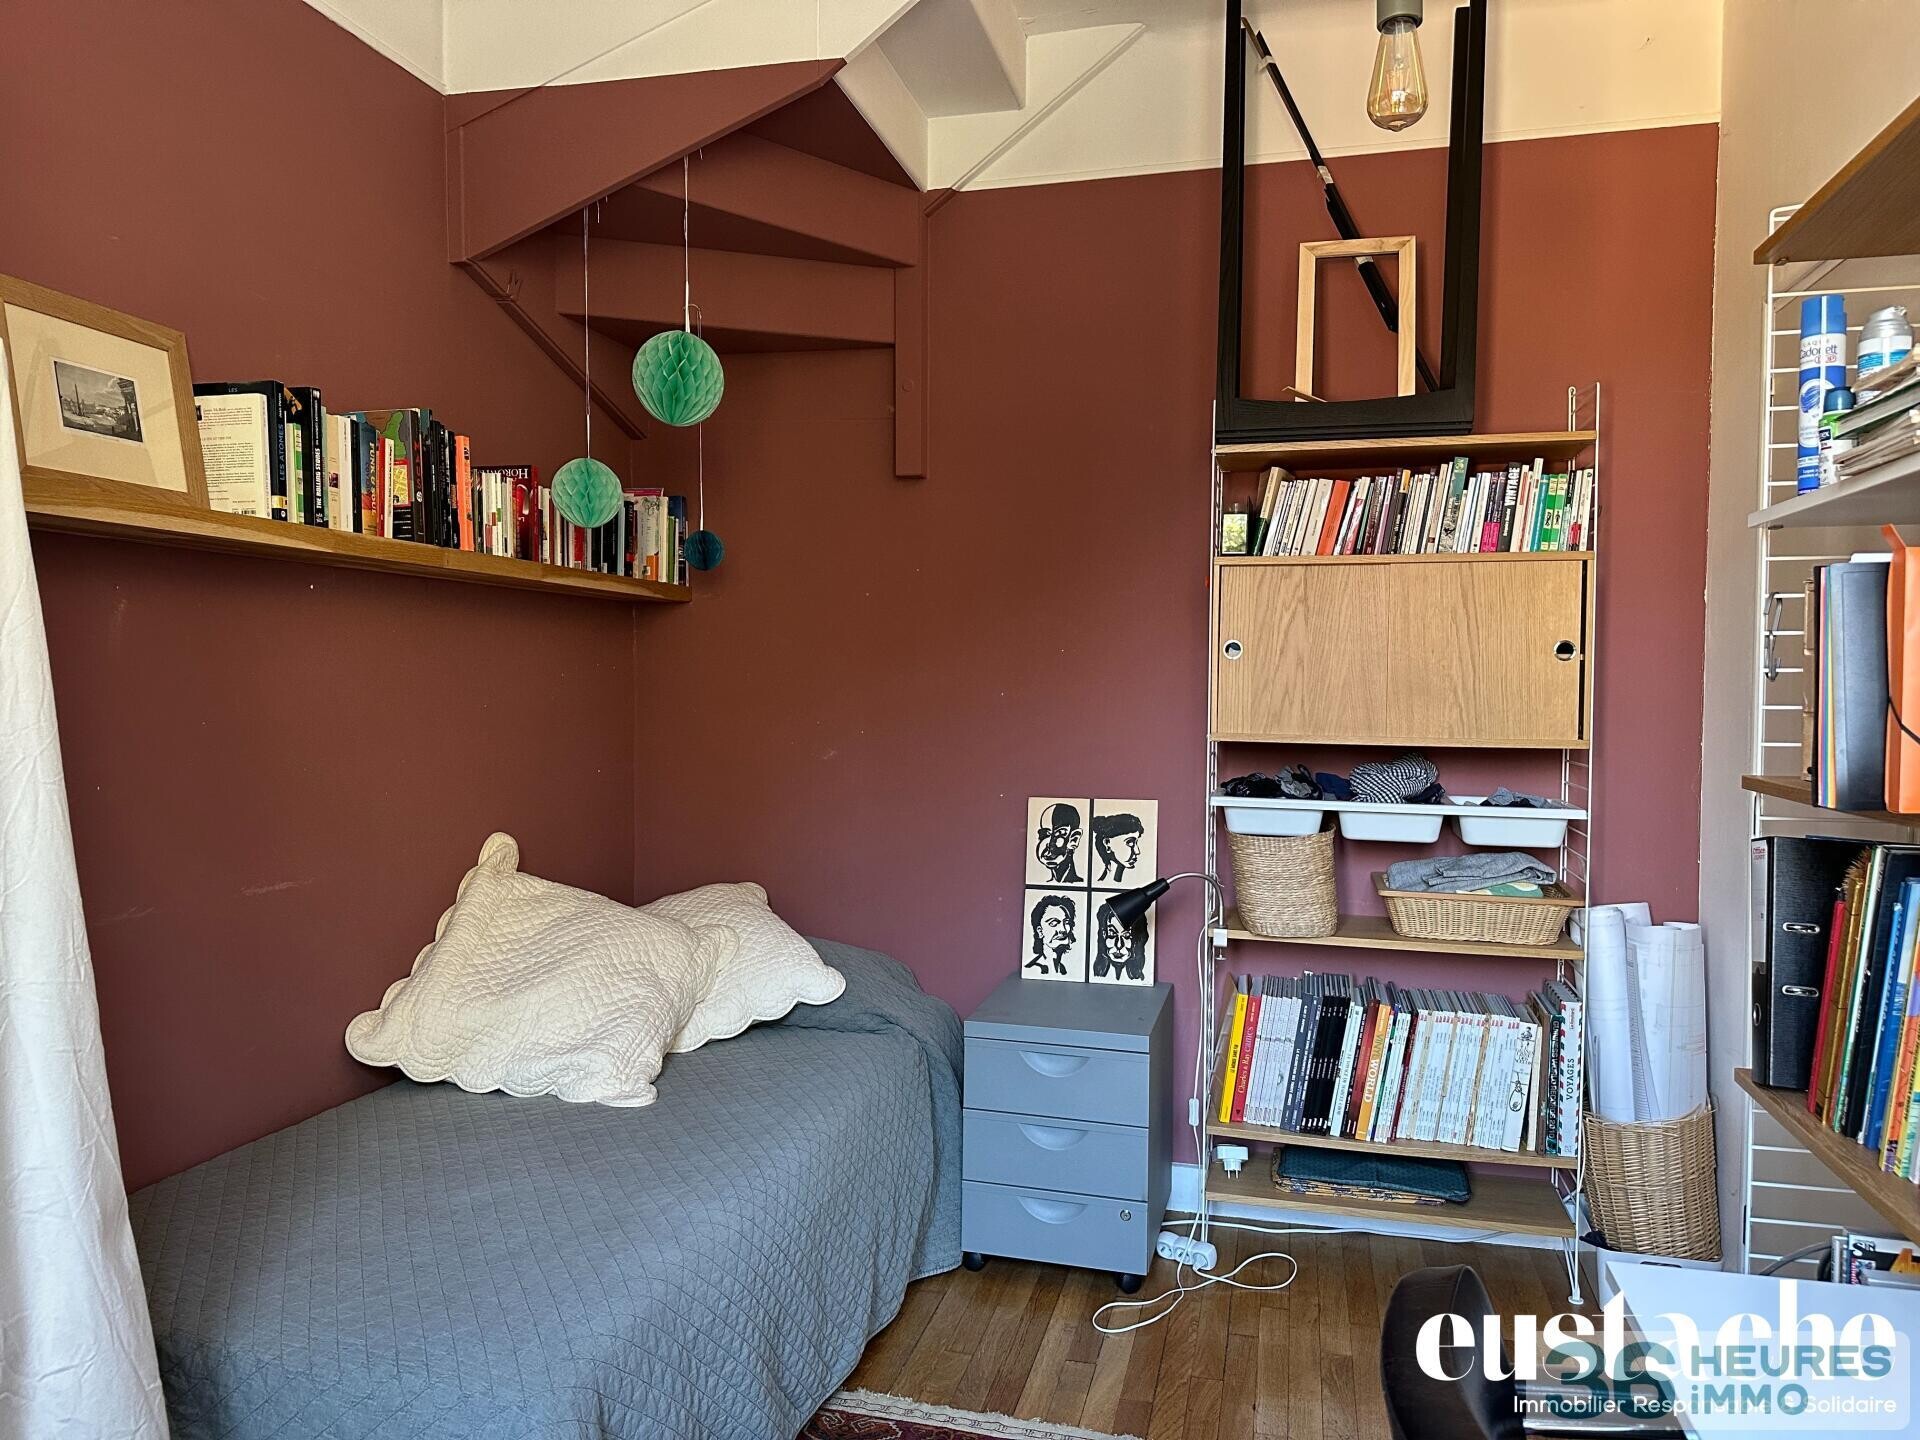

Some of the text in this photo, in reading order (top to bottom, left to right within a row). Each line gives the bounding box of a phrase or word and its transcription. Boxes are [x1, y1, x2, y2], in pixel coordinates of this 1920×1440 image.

[1504, 467, 1520, 506] VINTAGE
[1242, 1053, 1251, 1065] Ray
[1548, 1020, 1559, 1138] GUINNESS WORLD RECORDS 2010
[1566, 1058, 1574, 1100] VOYAGES
[1237, 1070, 1248, 1093] Charles
[1364, 1058, 1380, 1103] WORLD
